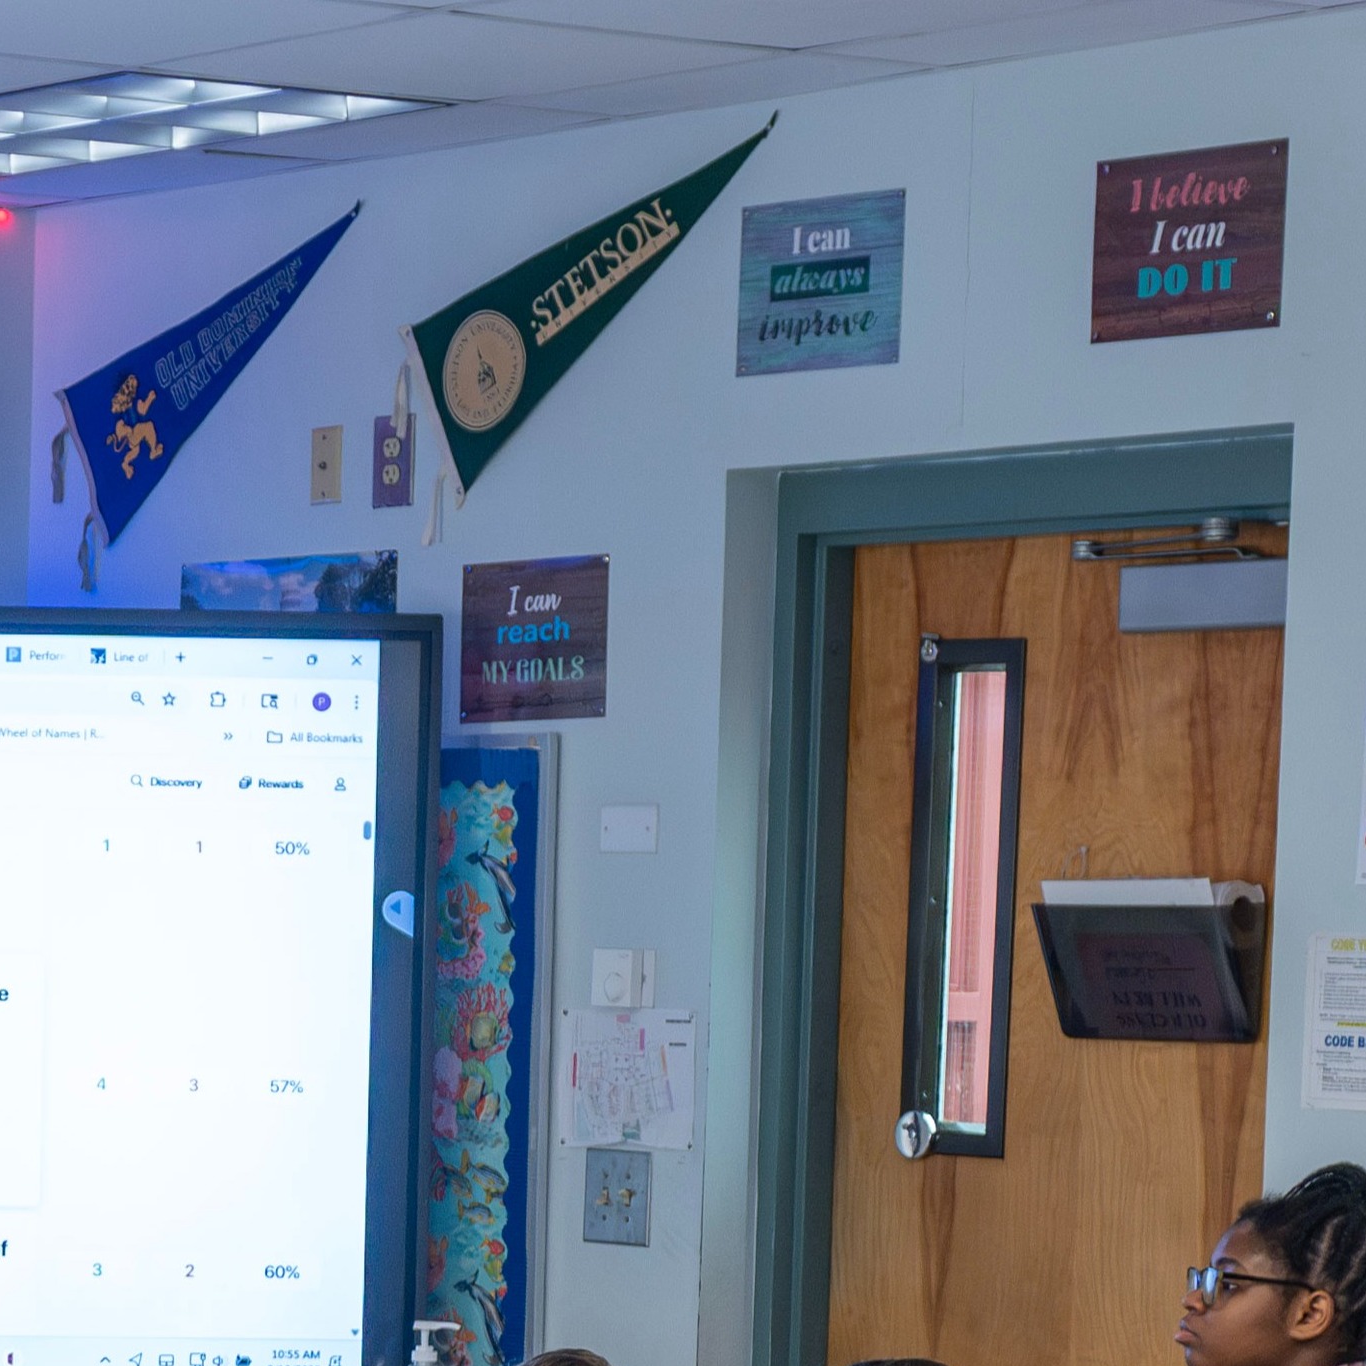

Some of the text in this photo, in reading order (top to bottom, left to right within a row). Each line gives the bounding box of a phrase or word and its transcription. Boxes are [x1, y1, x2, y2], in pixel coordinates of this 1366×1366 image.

[1130, 173, 1251, 213] I believe
[792, 224, 850, 255] I can
[1150, 219, 1226, 254] I can
[532, 198, 669, 330] STETSON
[1138, 258, 1237, 299] DO IT
[774, 266, 865, 295] always
[759, 310, 876, 345] improve
[155, 340, 195, 388] OLD
[506, 585, 562, 616] I can
[497, 616, 570, 644] reach
[482, 655, 585, 685] MY GOALS
[150, 776, 304, 790] Discovery Rewards
[275, 841, 310, 856] 50%
[1325, 1035, 1355, 1048] CODE
[270, 1079, 304, 1094] 57%
[264, 1265, 300, 1279] 60%
[272, 1349, 321, 1360] 10:55 AM
